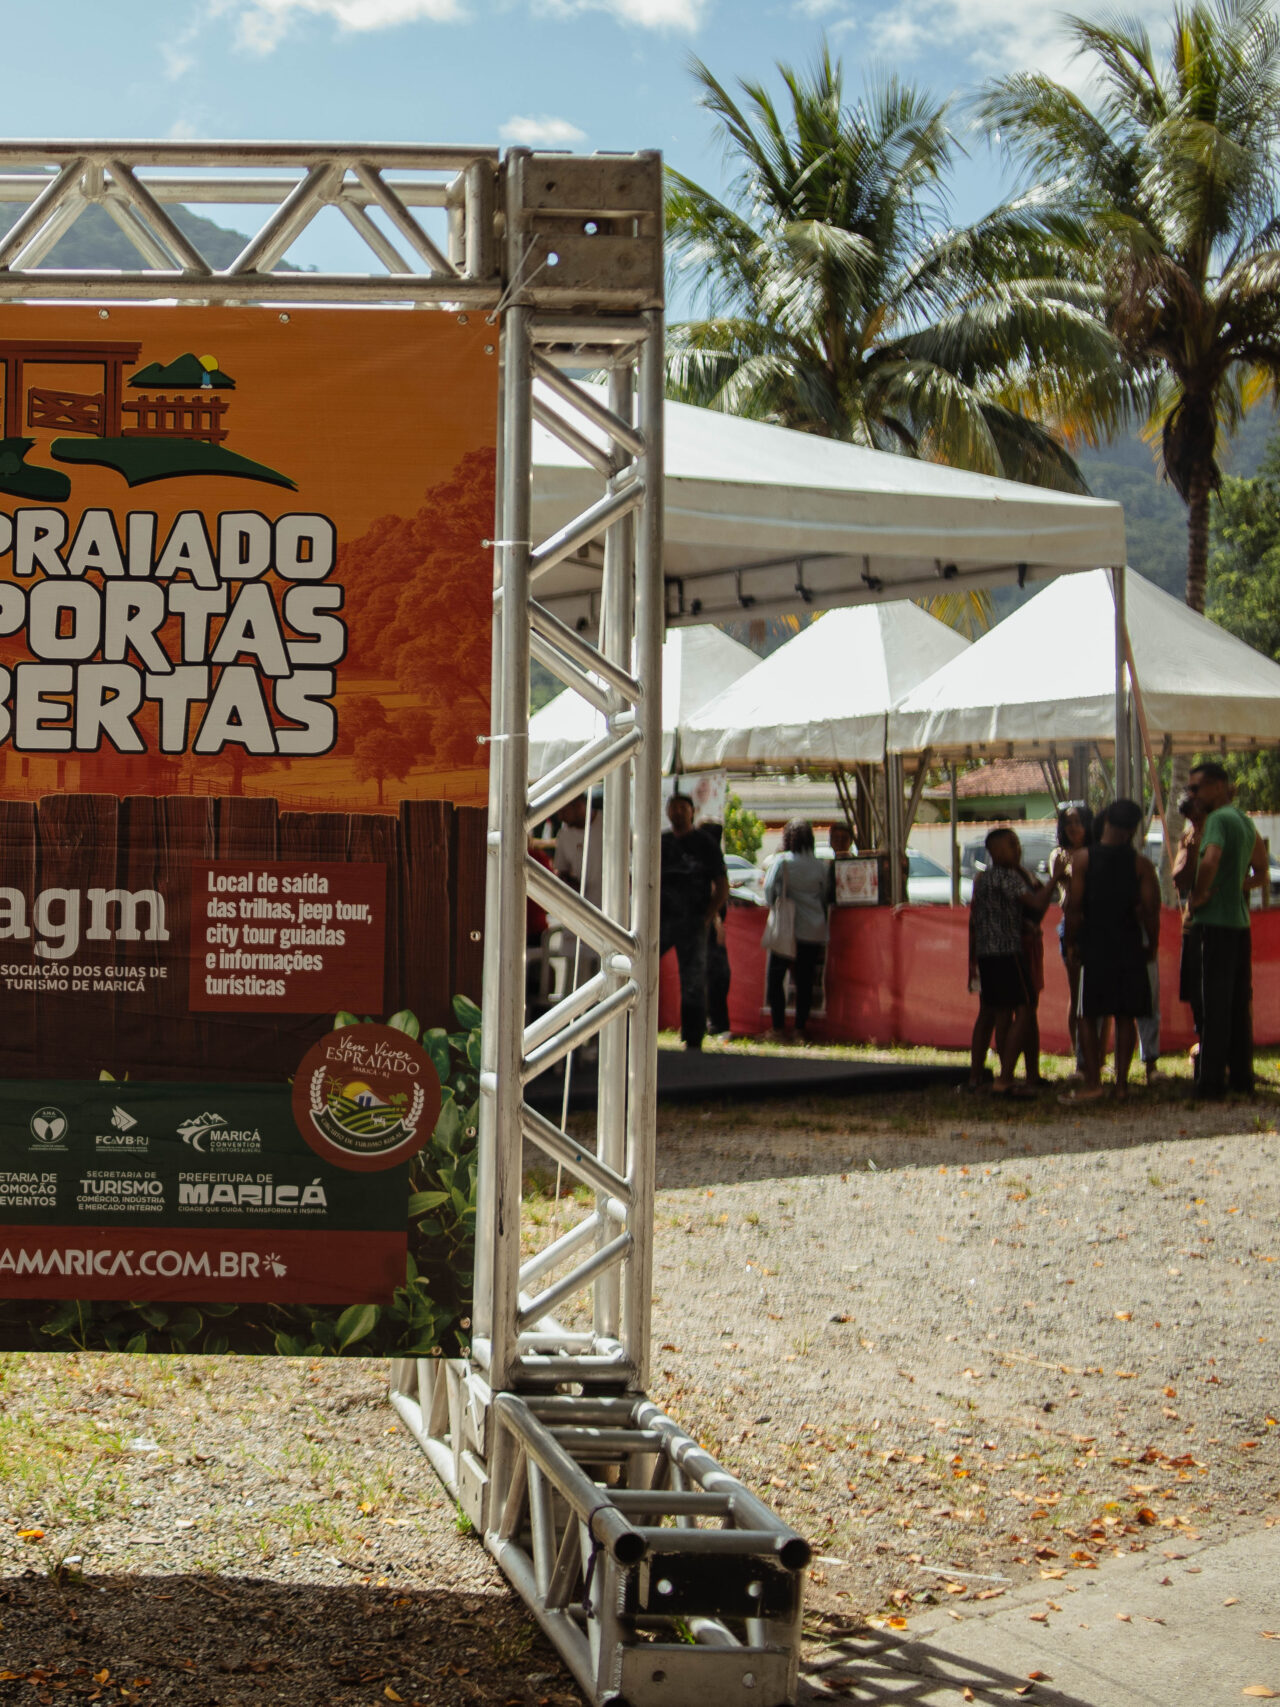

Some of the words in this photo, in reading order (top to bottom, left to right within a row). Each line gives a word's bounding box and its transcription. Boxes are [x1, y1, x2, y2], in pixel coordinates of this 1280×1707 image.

[207, 871, 253, 893] Local
[256, 872, 278, 893] de
[281, 873, 328, 894] saída
[206, 897, 236, 918] das
[239, 898, 295, 923] trilhas,
[297, 899, 332, 924] jeep
[335, 900, 372, 925] tour,
[206, 923, 238, 947] city
[242, 924, 277, 944] tour
[279, 925, 345, 949] guiadas
[205, 951, 216, 969] e
[219, 949, 323, 974] informações
[72, 966, 101, 977] DOS
[104, 966, 146, 977] GUIAS
[149, 967, 168, 978] DE
[5, 978, 69, 991] TURISMO
[71, 980, 90, 991] DE
[93, 978, 145, 992] MARICÁ
[205, 974, 286, 996] turísticas
[340, 1034, 369, 1053] Vem
[374, 1041, 412, 1060] Viver
[326, 1046, 420, 1075] ESPRAIADO
[210, 1128, 261, 1142] MARICÁ
[41, 1173, 57, 1182] DE
[178, 1172, 253, 1182] PREFEITURA
[256, 1173, 272, 1183] DE
[79, 1179, 163, 1195] TURISMO
[178, 1177, 328, 1207] MARICÁ
[0, 1196, 57, 1206] EVENTOS
[76, 1194, 120, 1203] COMÉRCIO,
[121, 1195, 166, 1203] INDÚSTRIA
[127, 1204, 163, 1212] INTERNO
